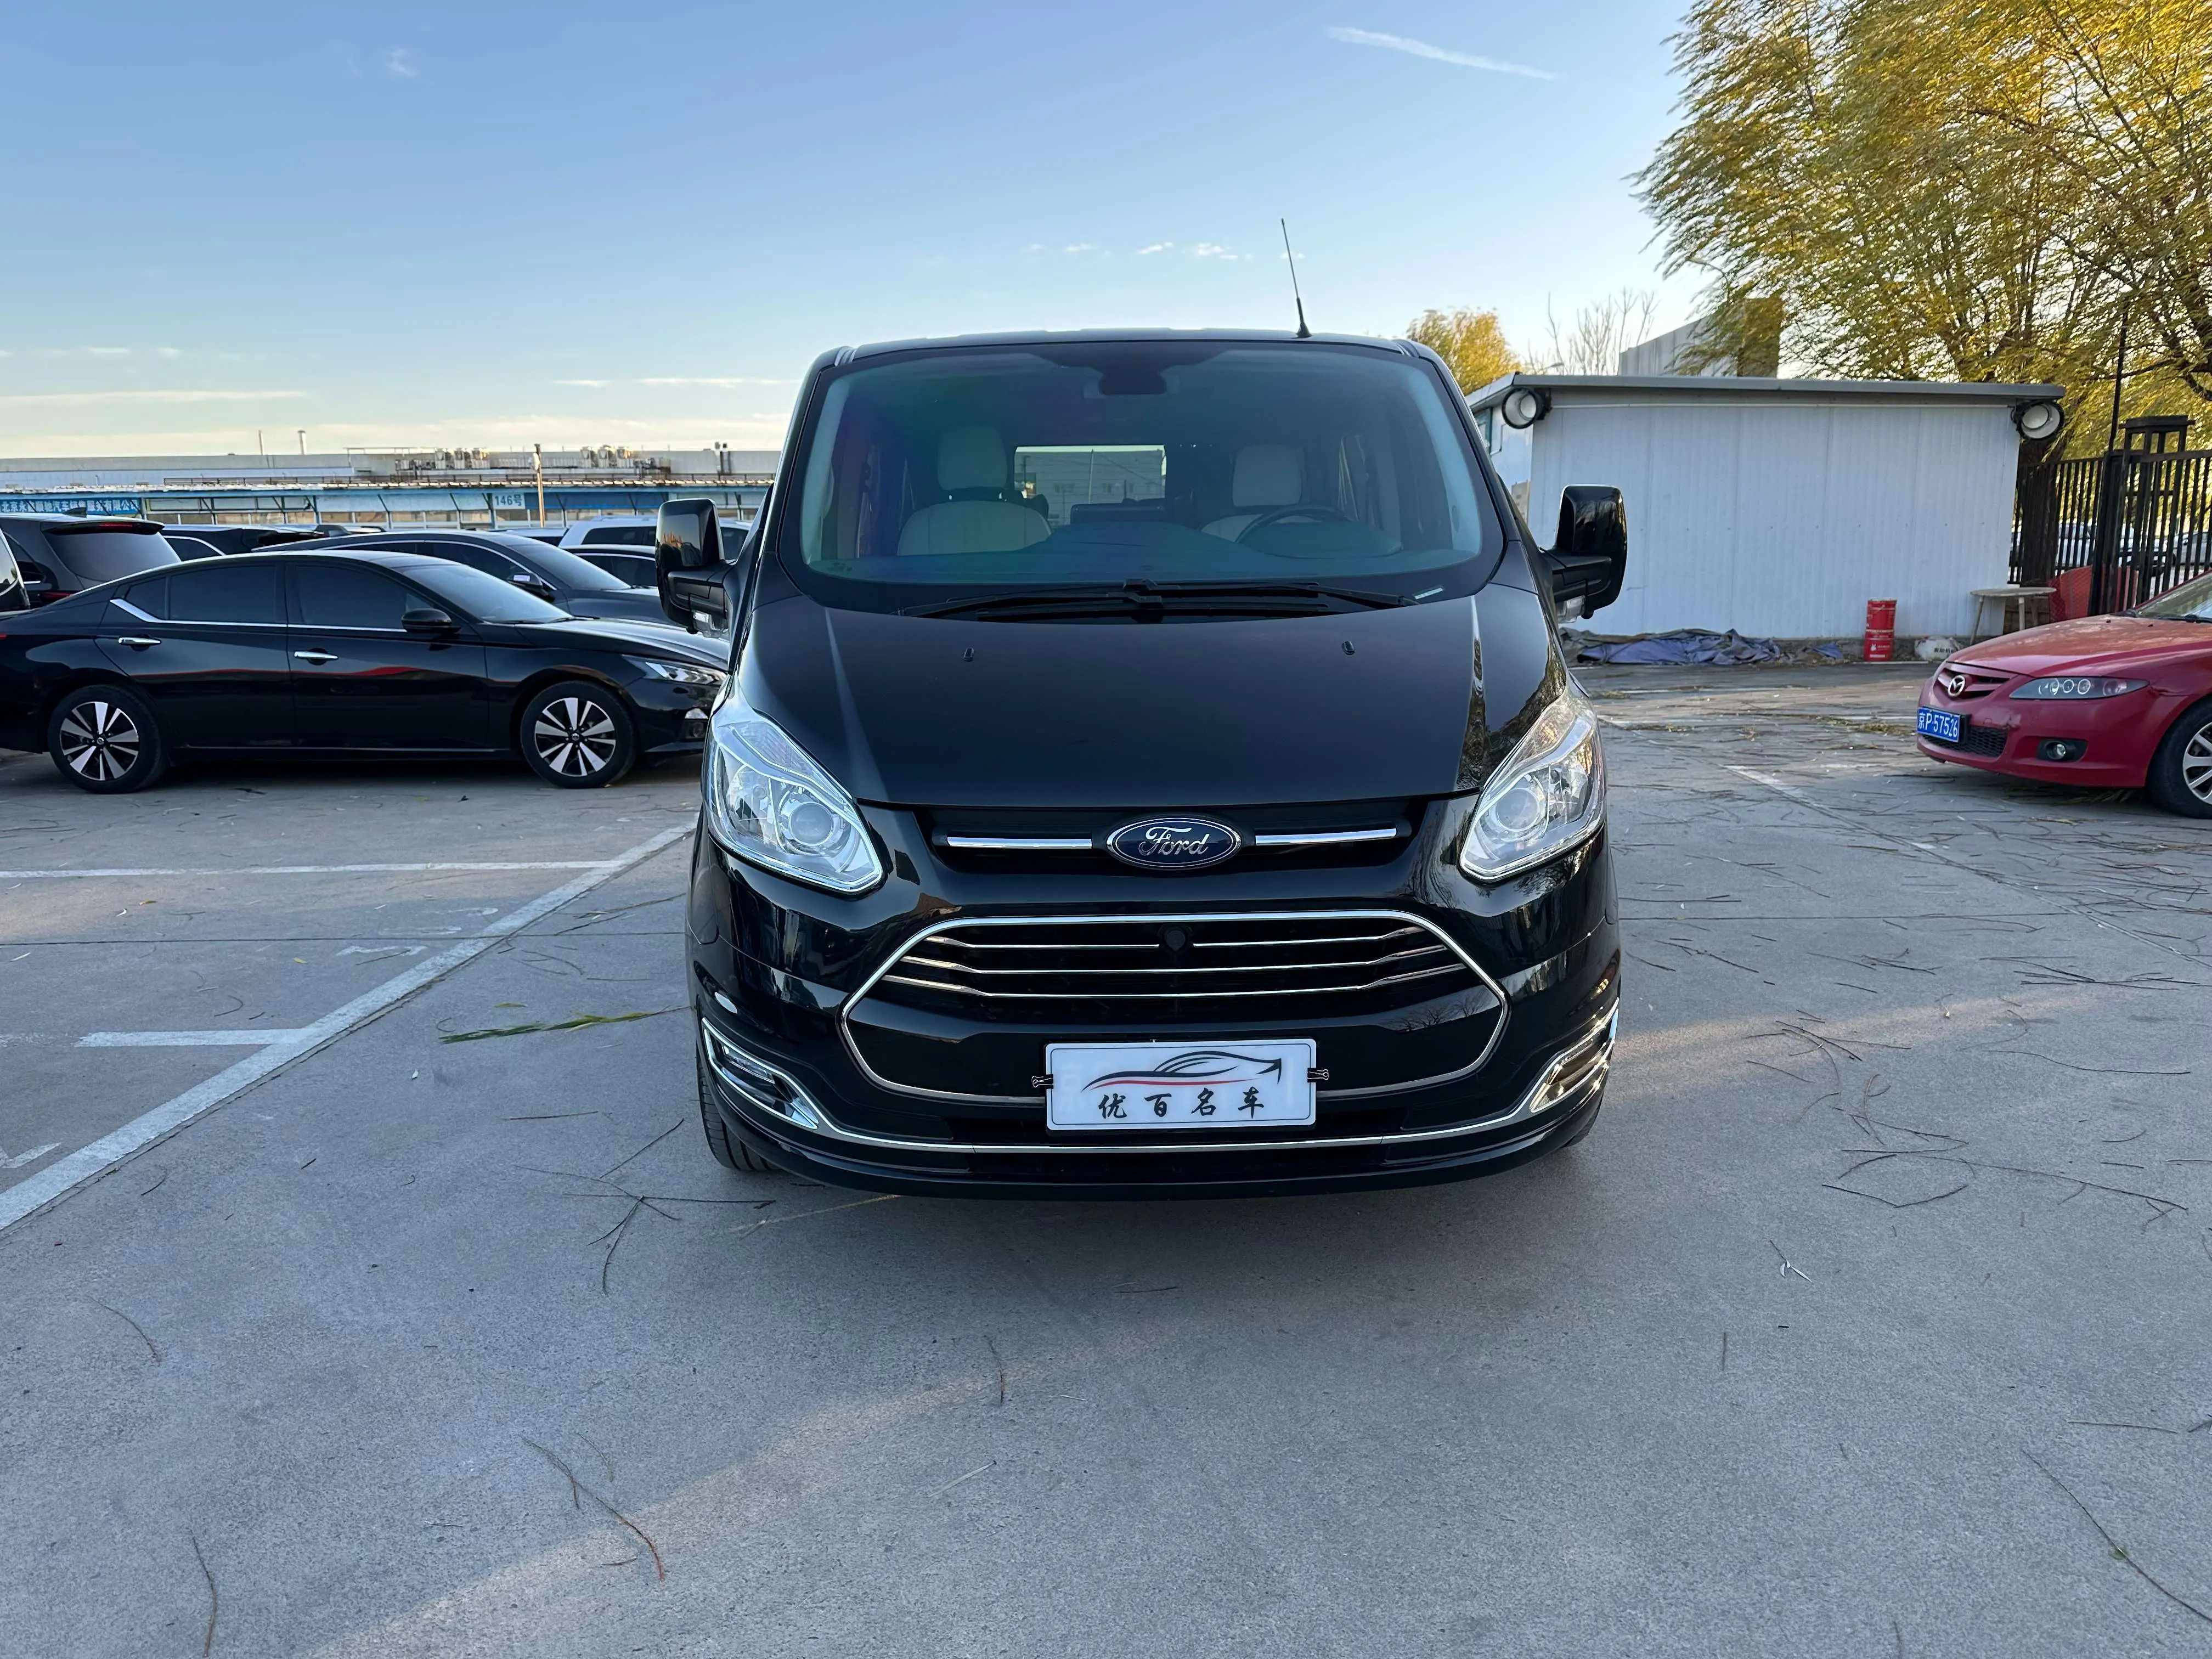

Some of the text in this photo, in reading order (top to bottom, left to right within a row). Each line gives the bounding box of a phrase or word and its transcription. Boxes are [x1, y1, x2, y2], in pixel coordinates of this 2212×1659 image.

[495, 494, 522, 506] 146号
[1138, 826, 1210, 856] Ford
[1098, 1086, 1264, 1119] 优百名车
